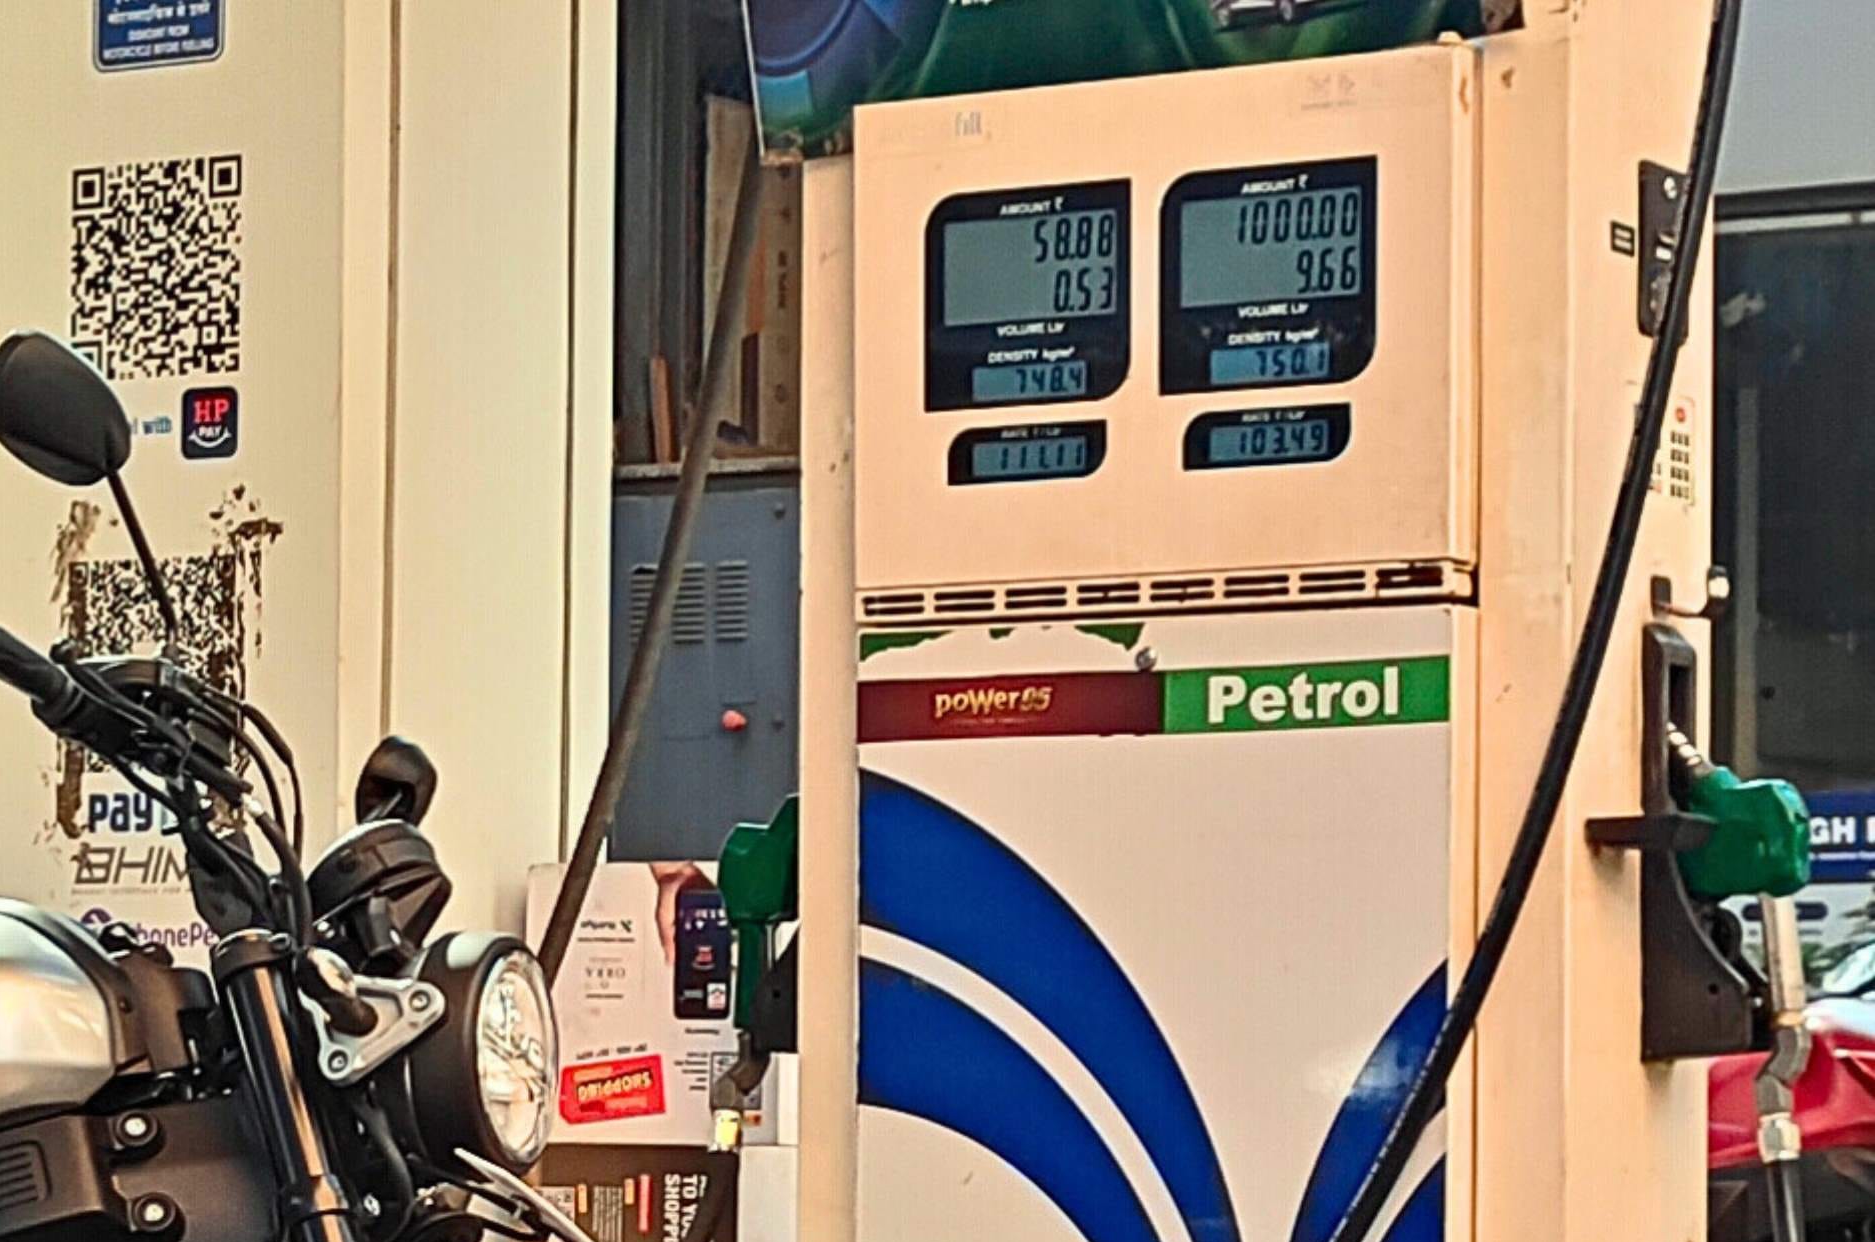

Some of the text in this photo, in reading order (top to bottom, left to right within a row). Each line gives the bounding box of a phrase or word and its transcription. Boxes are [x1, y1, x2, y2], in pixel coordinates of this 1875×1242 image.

[1240, 178, 1295, 195] AMOUNT
[1000, 200, 1051, 216] AMOUNT
[1237, 192, 1359, 245] 1000.00
[1034, 214, 1115, 264] 58.88
[1296, 246, 1357, 294] 9.66
[1053, 266, 1114, 313] 0.53
[1237, 304, 1288, 319] VOLUME
[996, 323, 1045, 337] VOLUME
[1228, 330, 1281, 345] DENSITY
[987, 348, 1039, 364] DENSITY
[194, 398, 230, 423] HP
[198, 424, 222, 438] PAY
[1239, 424, 1325, 455] 103.49
[1207, 666, 1399, 725] Petrol
[134, 921, 215, 947] honePe
[681, 1174, 698, 1200] TO
